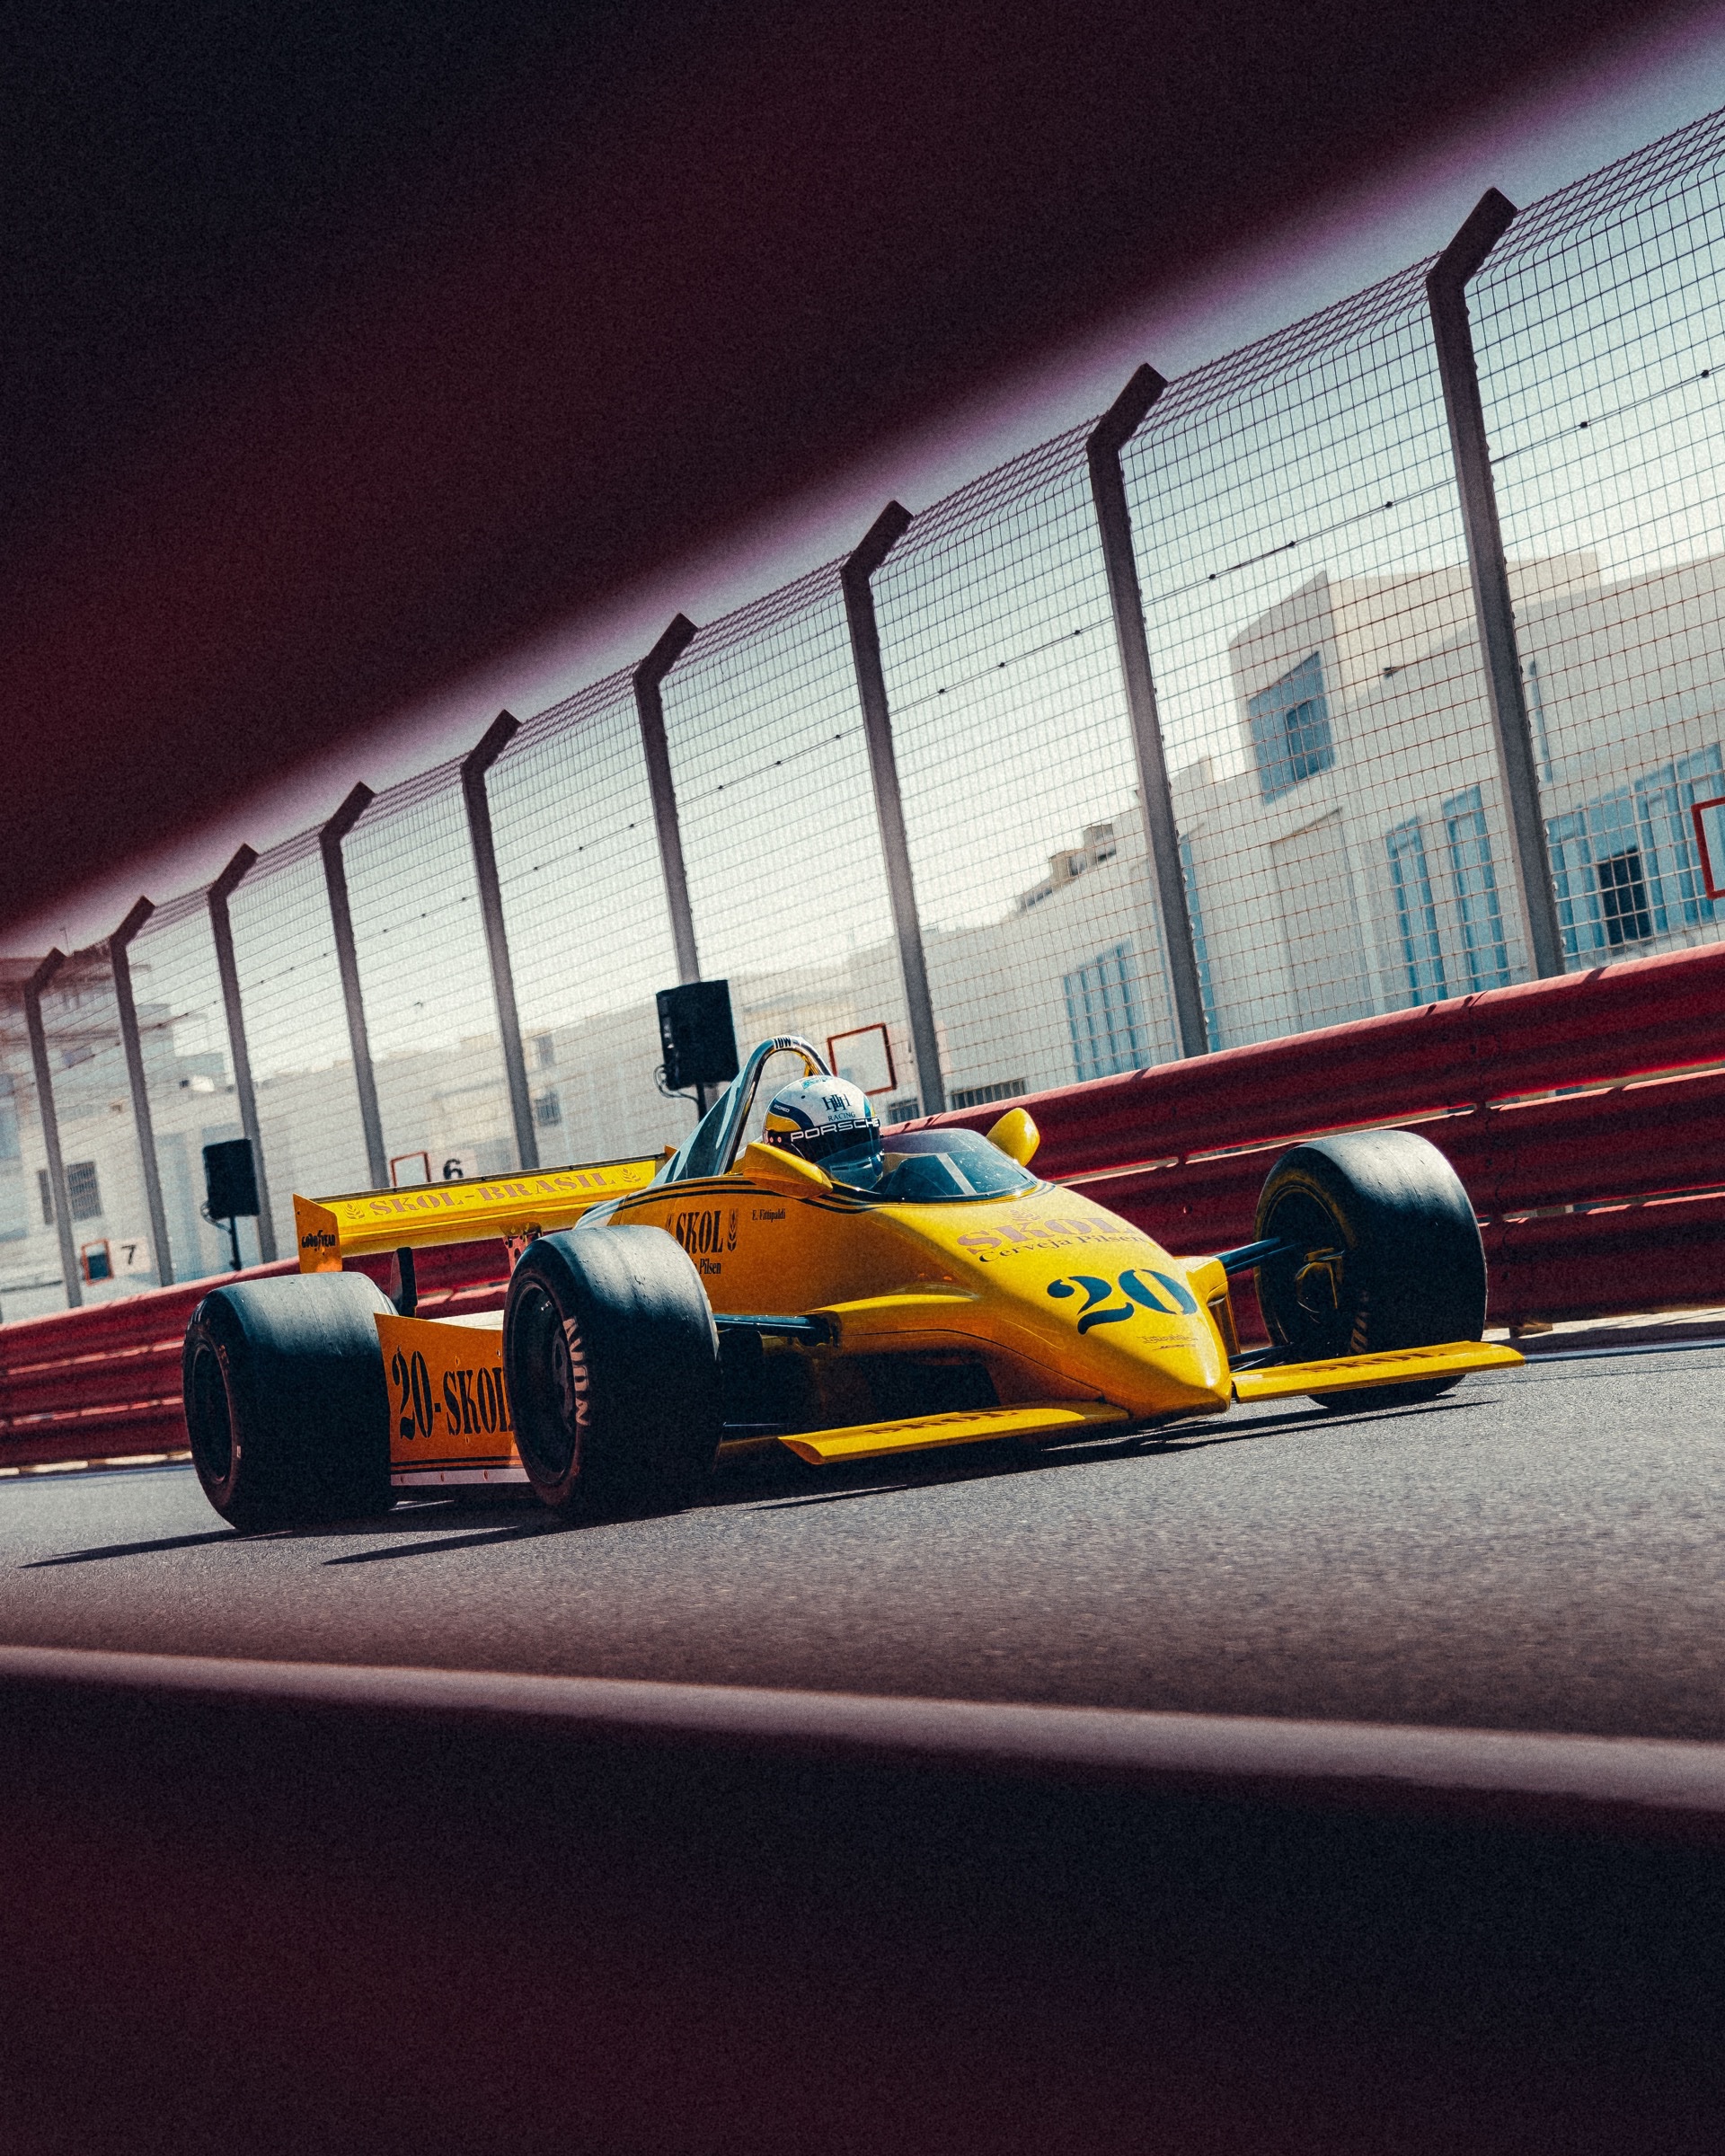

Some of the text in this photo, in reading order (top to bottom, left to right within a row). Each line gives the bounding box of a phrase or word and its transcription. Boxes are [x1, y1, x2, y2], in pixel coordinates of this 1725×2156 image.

[827, 1111, 856, 1121] RACING
[791, 1118, 880, 1142] PORSCHE
[443, 1158, 464, 1180] 6
[369, 1172, 615, 1216] SKOL-BRASIL
[752, 1208, 786, 1223] E. Fittipaldi
[676, 1210, 724, 1255] SKOL
[957, 1217, 1136, 1255] SKOL
[120, 1244, 137, 1265] 7
[978, 1233, 1149, 1263] Cerveja Pilsen
[699, 1258, 721, 1275] Pilsen
[1047, 1267, 1199, 1335] 20
[1299, 1352, 1447, 1373] SKOL
[863, 1412, 1019, 1434] SKOL
